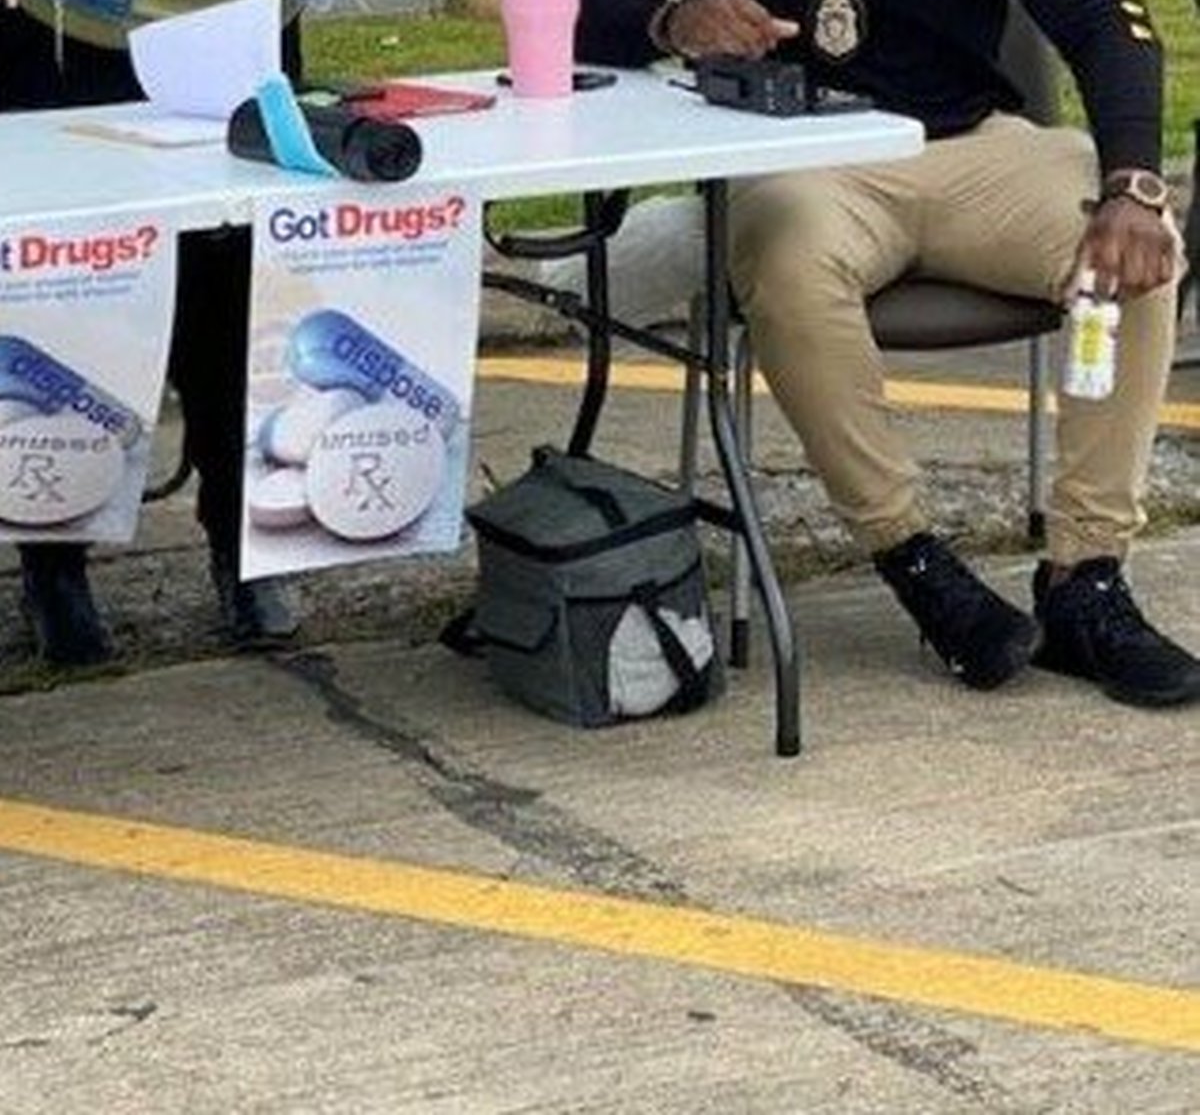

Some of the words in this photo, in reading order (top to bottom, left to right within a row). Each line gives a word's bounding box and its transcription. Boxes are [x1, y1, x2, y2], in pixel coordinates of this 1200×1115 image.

[270, 207, 331, 243] Got
[336, 196, 466, 240] Drugs?
[21, 226, 159, 271] Drugs?
